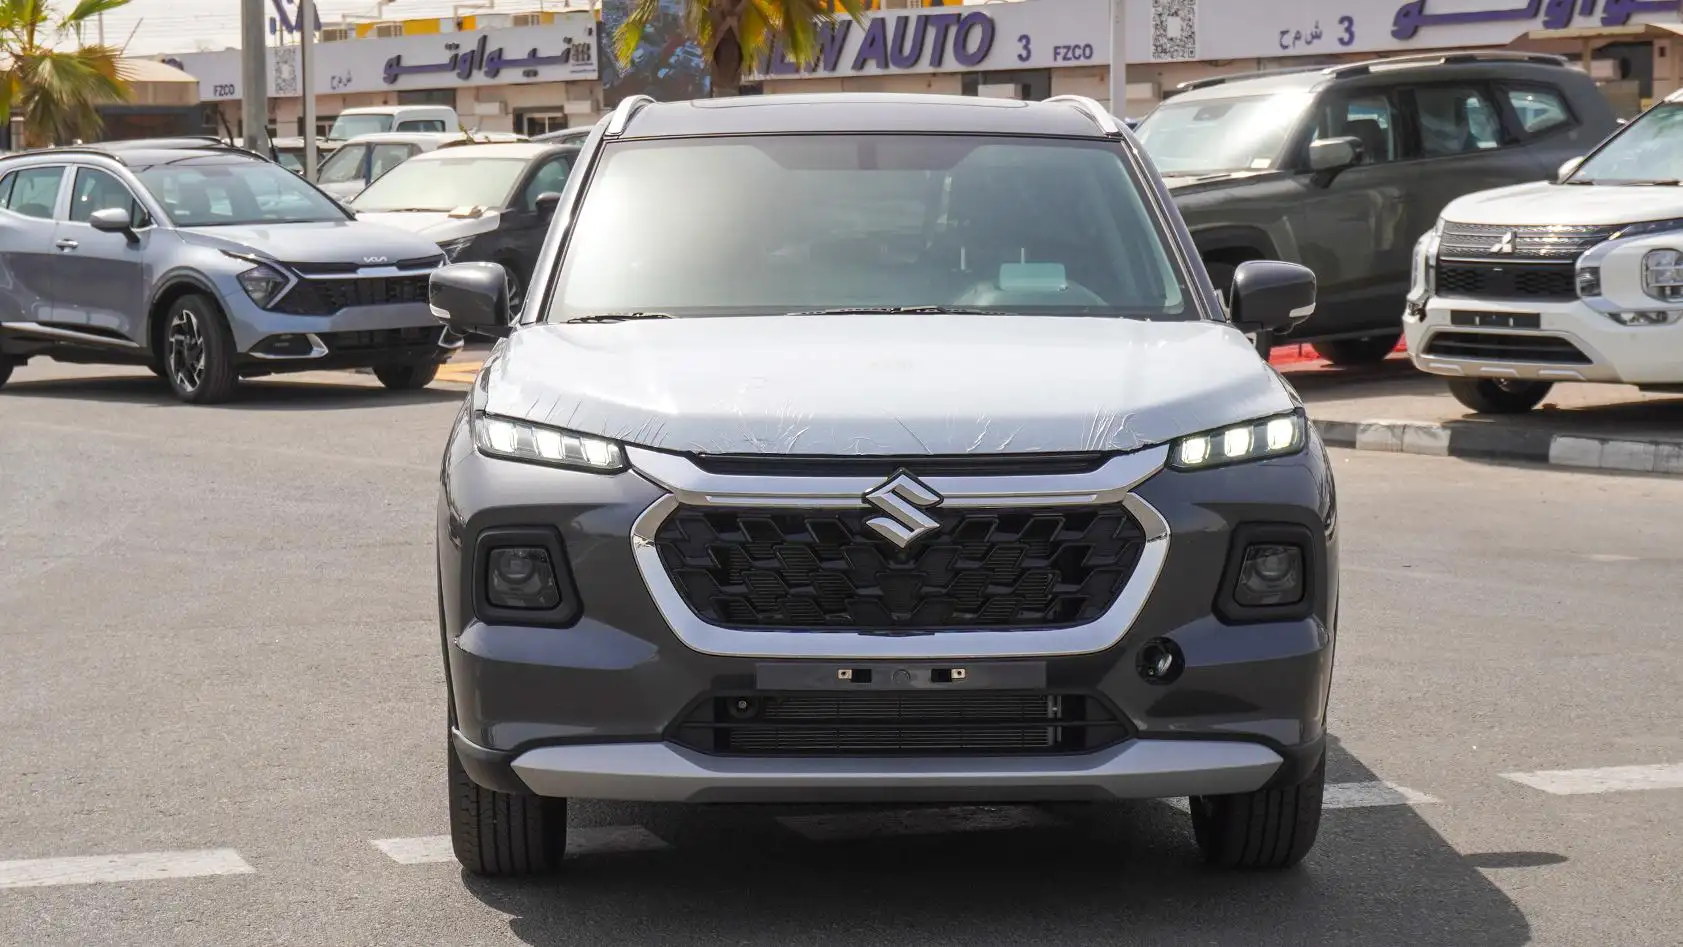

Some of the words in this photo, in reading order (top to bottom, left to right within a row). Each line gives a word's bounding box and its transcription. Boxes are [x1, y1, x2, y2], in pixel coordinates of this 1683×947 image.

[851, 11, 995, 71] AUTO
[1017, 34, 1032, 62] 3
[1053, 43, 1094, 62] FZCO
[1337, 15, 1355, 46] 3
[213, 83, 235, 97] FZCO
